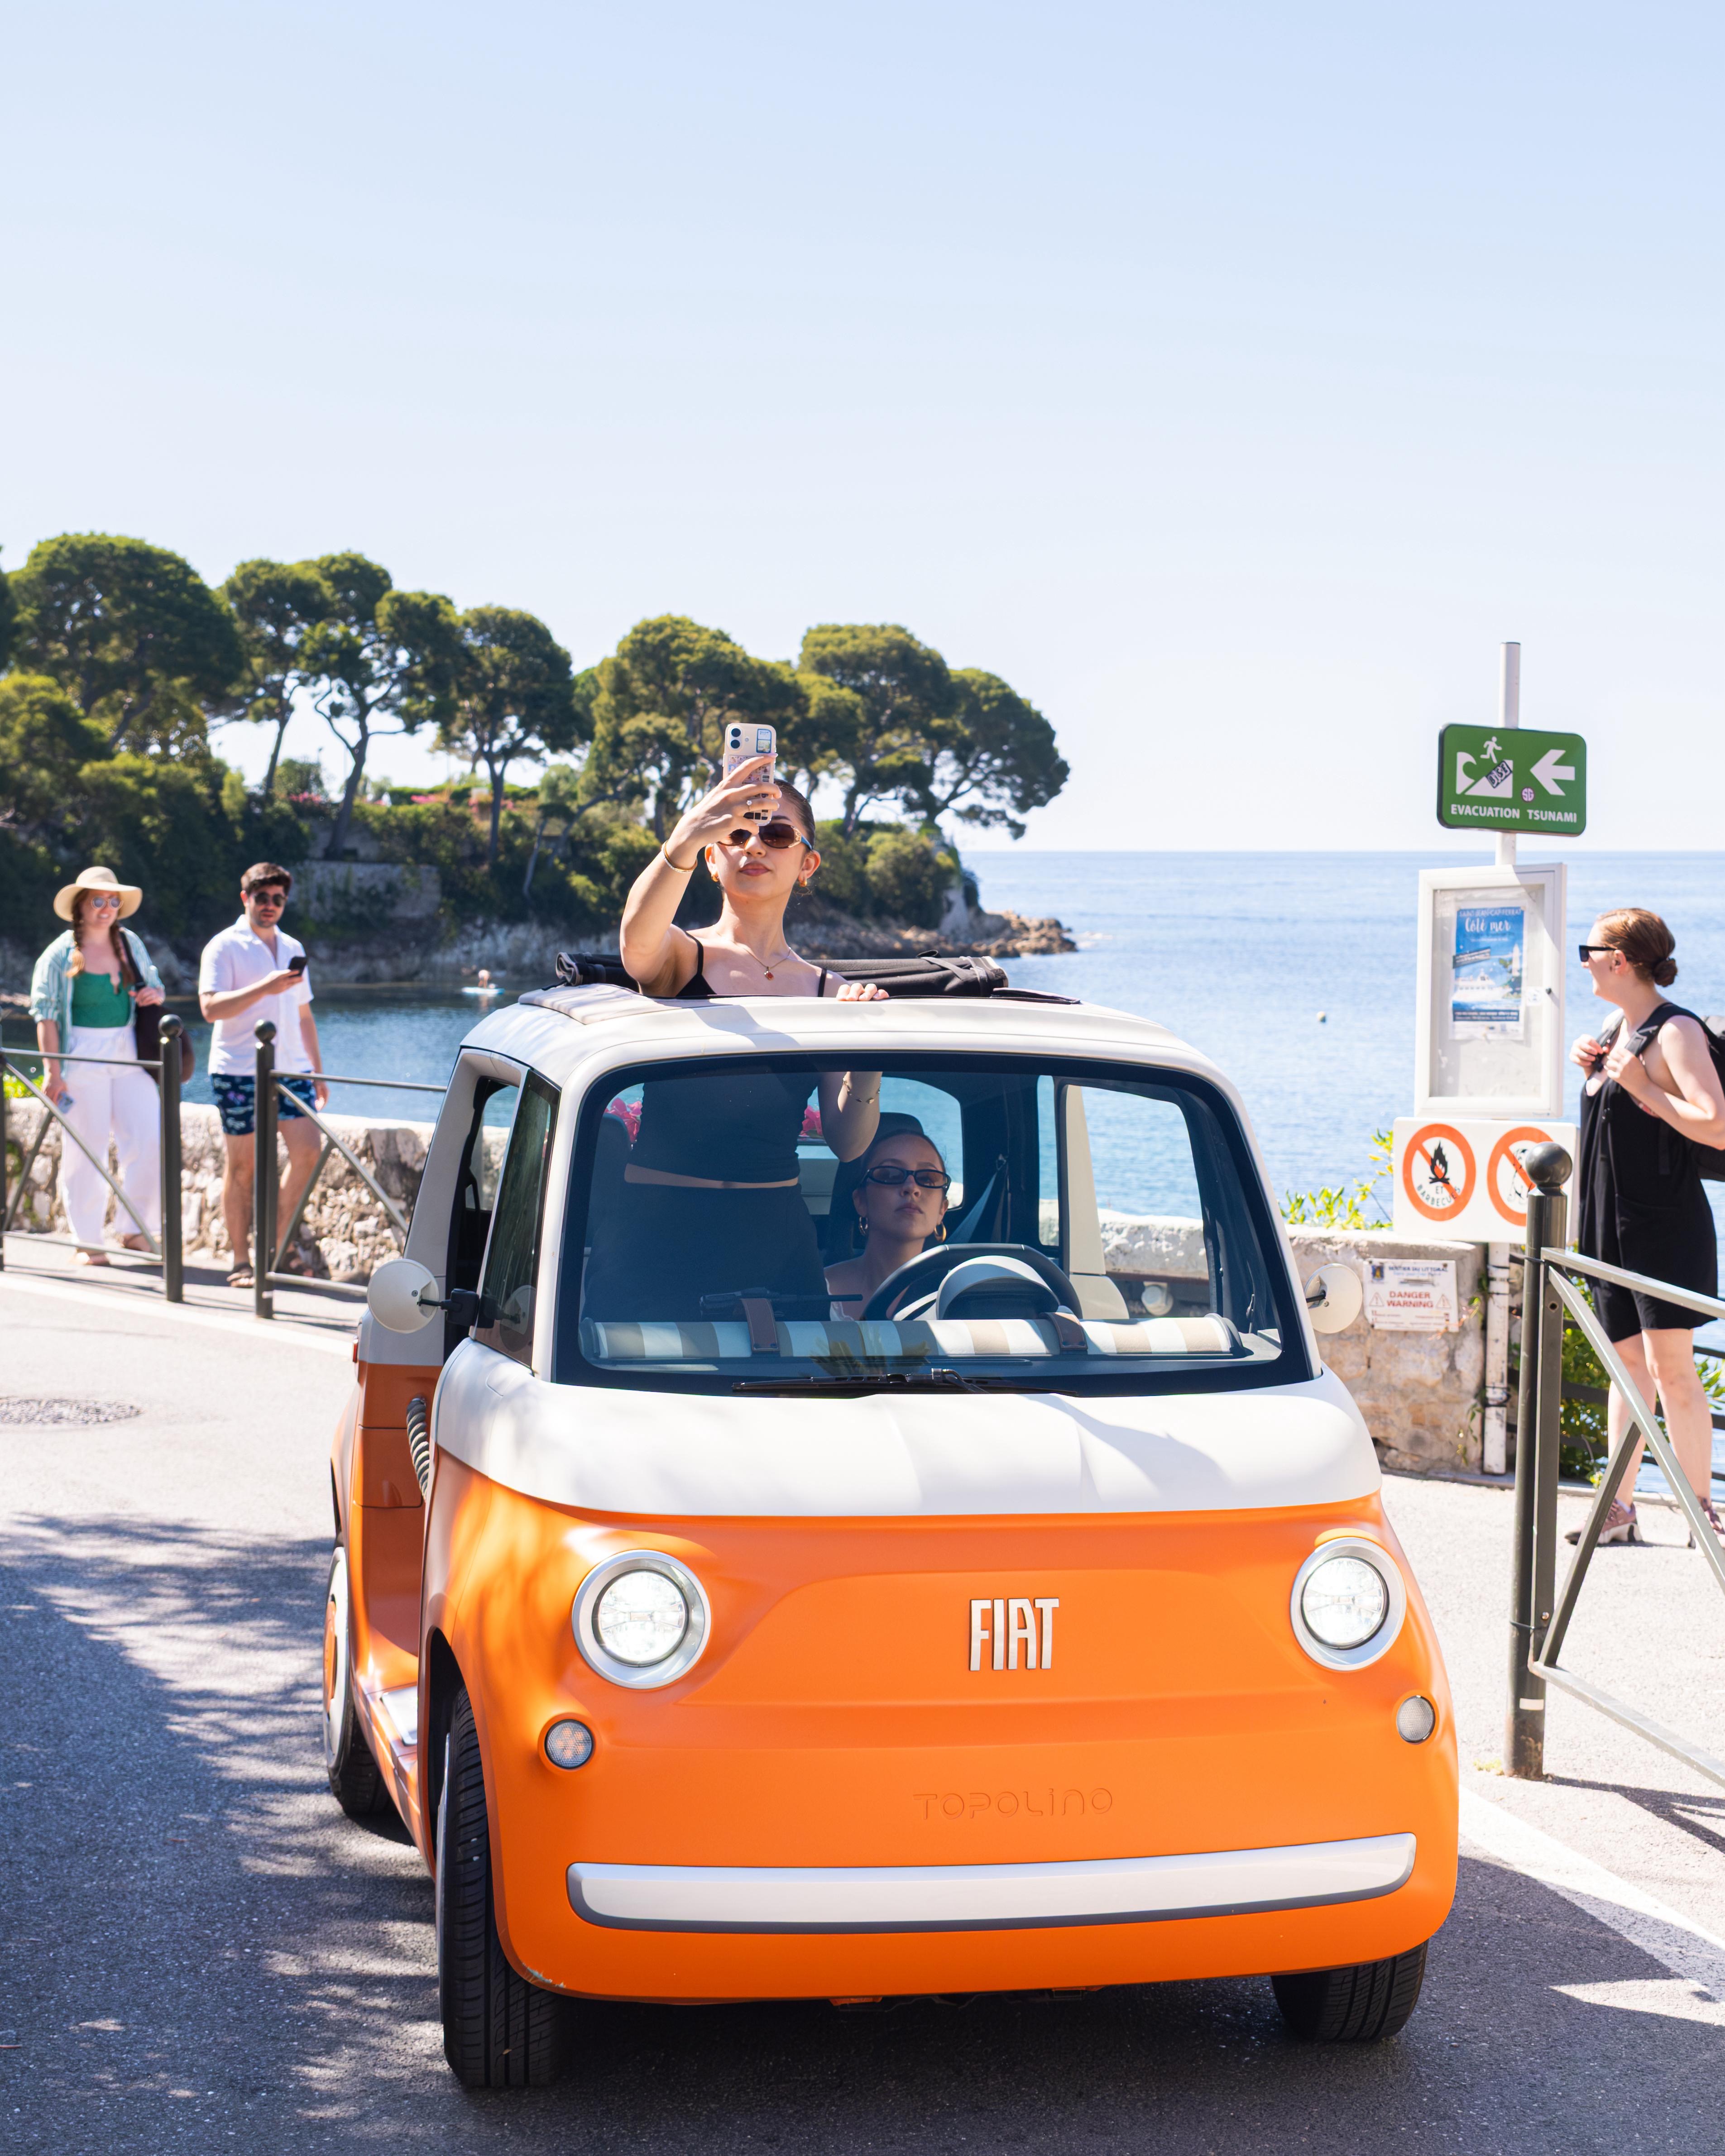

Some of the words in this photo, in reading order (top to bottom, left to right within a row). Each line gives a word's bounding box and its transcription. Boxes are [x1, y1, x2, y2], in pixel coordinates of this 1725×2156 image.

[1451, 804, 1520, 819] EVACUATION
[1527, 810, 1577, 823] TSUNAMI
[1417, 1184, 1461, 1206] BARBECUES
[1436, 1186, 1443, 1194] ET
[970, 1598, 1059, 1671] FIAT
